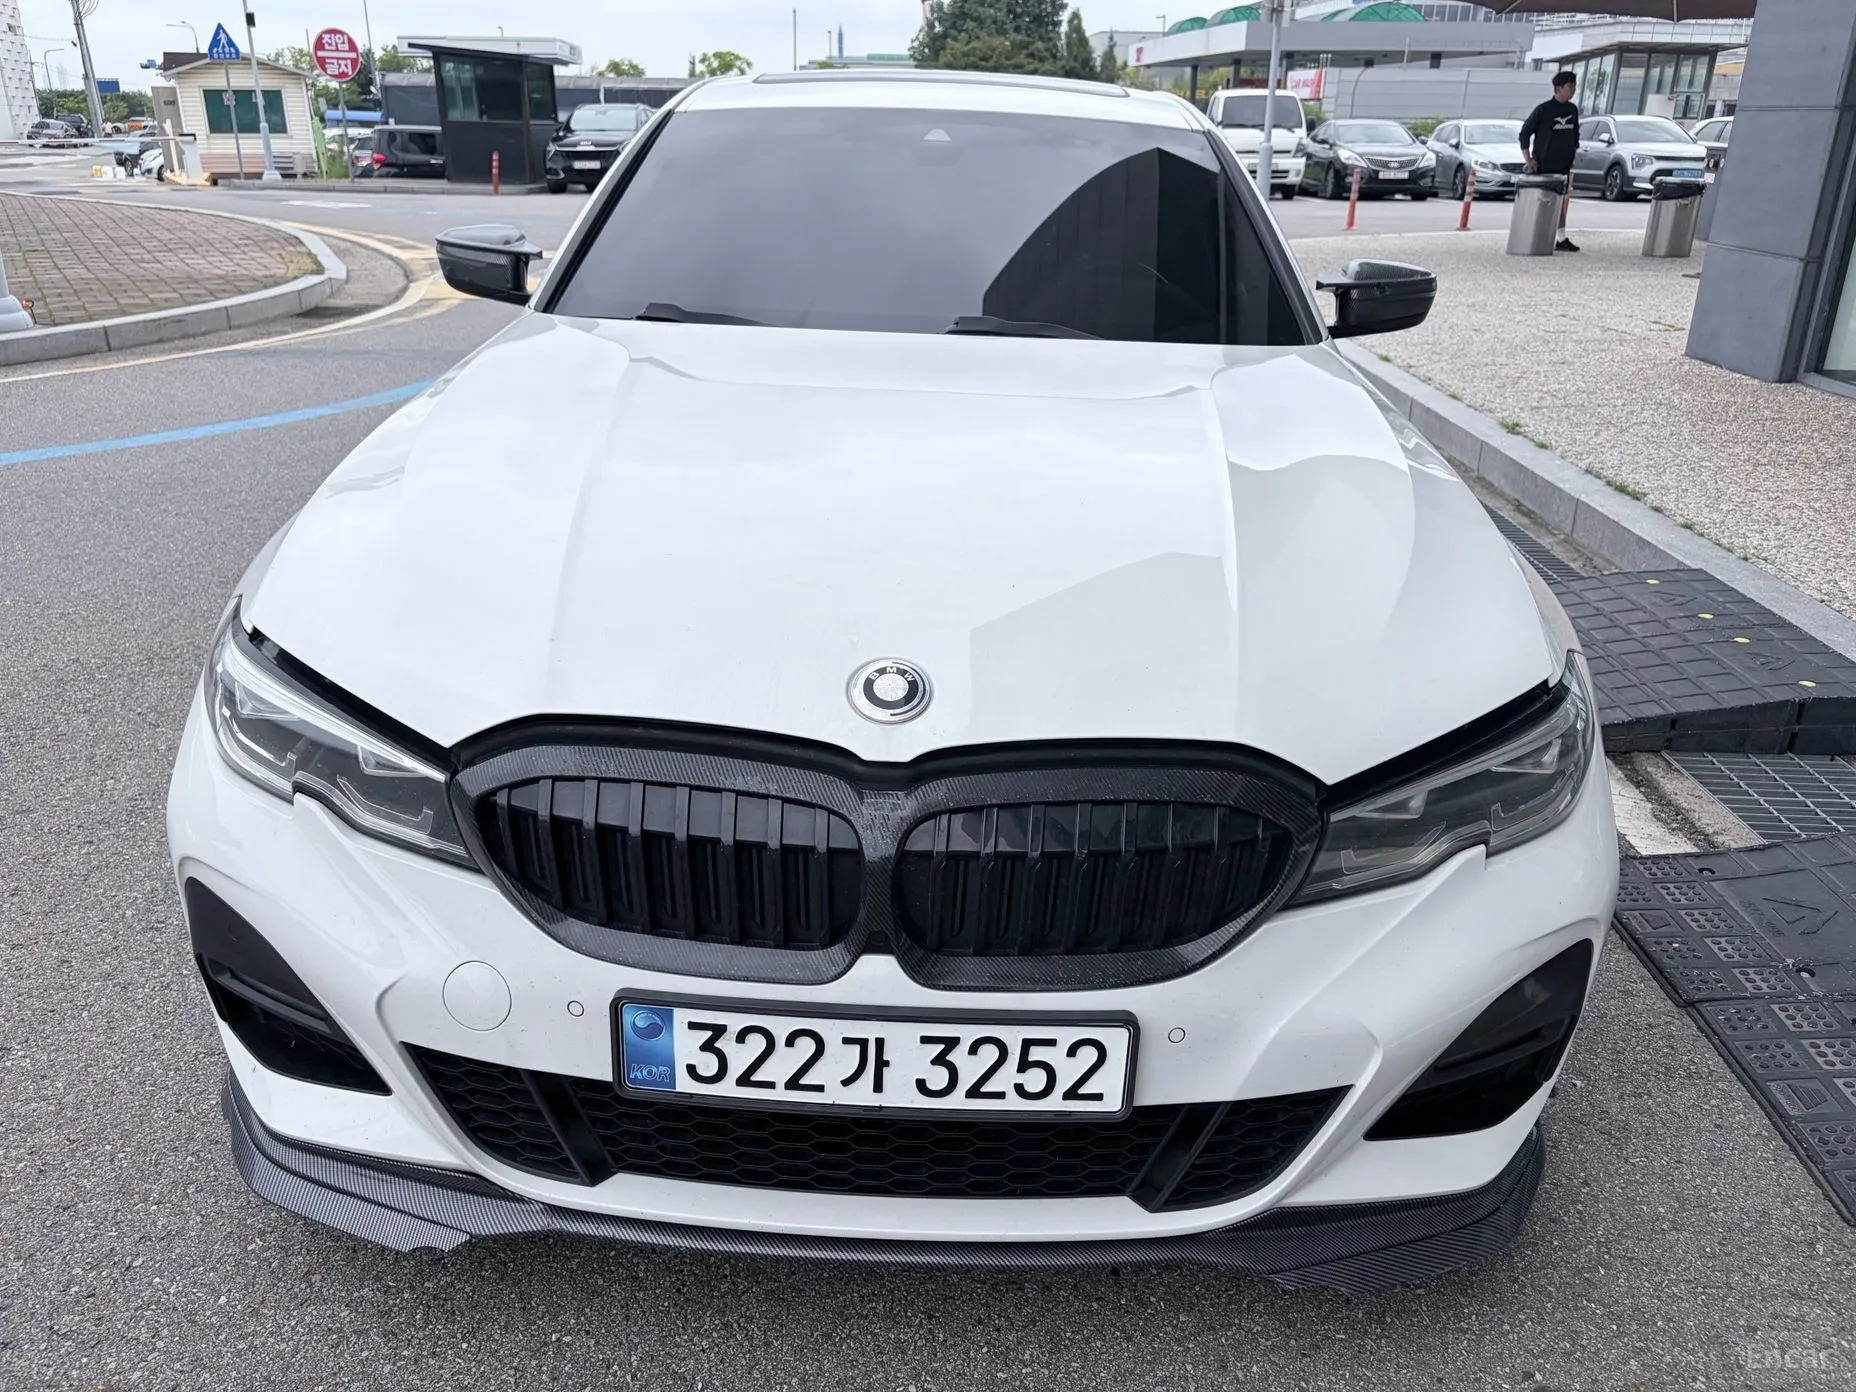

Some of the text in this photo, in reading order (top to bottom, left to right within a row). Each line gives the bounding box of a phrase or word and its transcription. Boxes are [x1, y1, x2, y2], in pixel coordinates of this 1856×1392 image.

[321, 33, 349, 51] 진입
[325, 58, 352, 76] 금지
[869, 666, 915, 682] BMW
[685, 1020, 1108, 1102] 322가 3252
[629, 1063, 671, 1082] KOR
